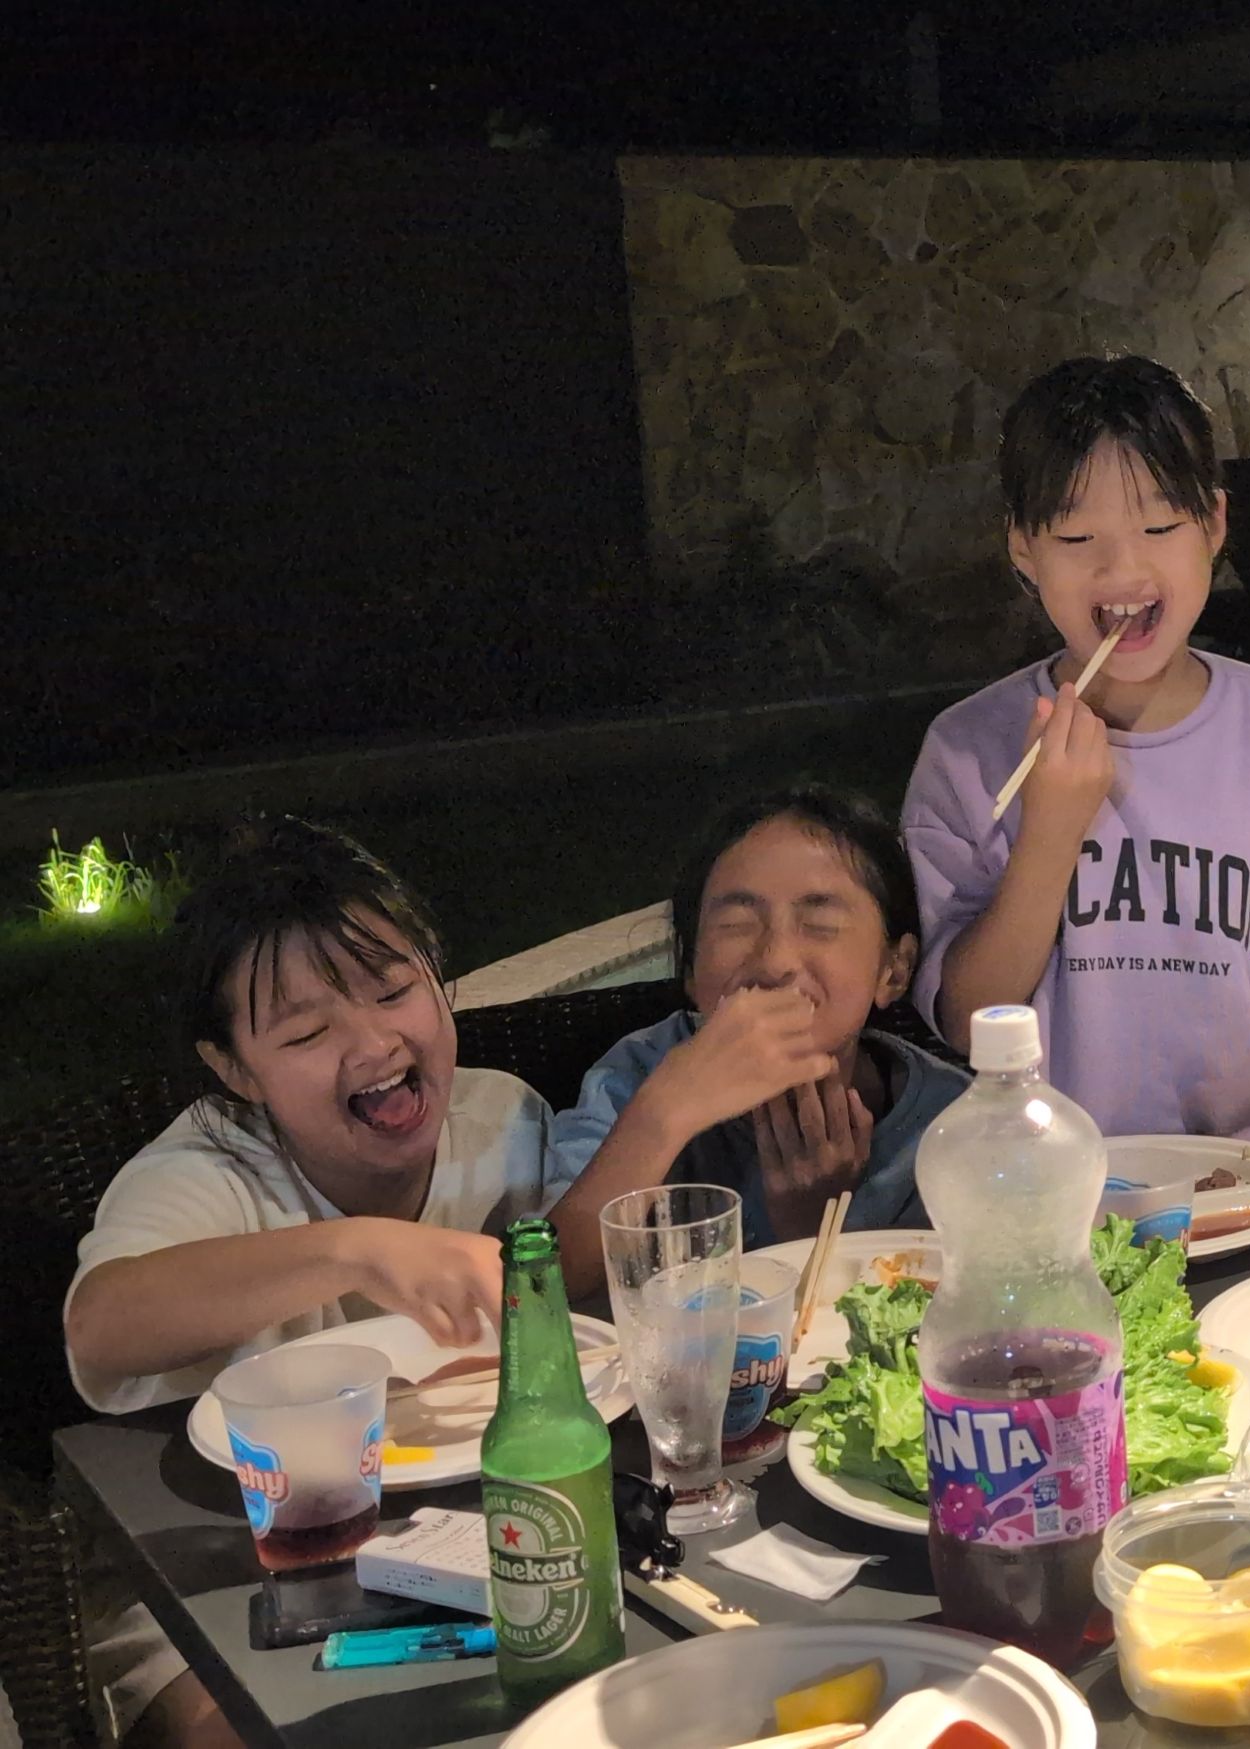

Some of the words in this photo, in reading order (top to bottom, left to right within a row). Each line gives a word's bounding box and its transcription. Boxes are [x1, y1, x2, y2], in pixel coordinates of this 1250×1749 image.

[1129, 957, 1144, 971] IS
[1147, 958, 1158, 972] A
[1161, 959, 1198, 975] NEW
[1199, 961, 1232, 977] DAY
[511, 1499, 564, 1542] ORIGINAL
[534, 1608, 568, 1640] LAGER
